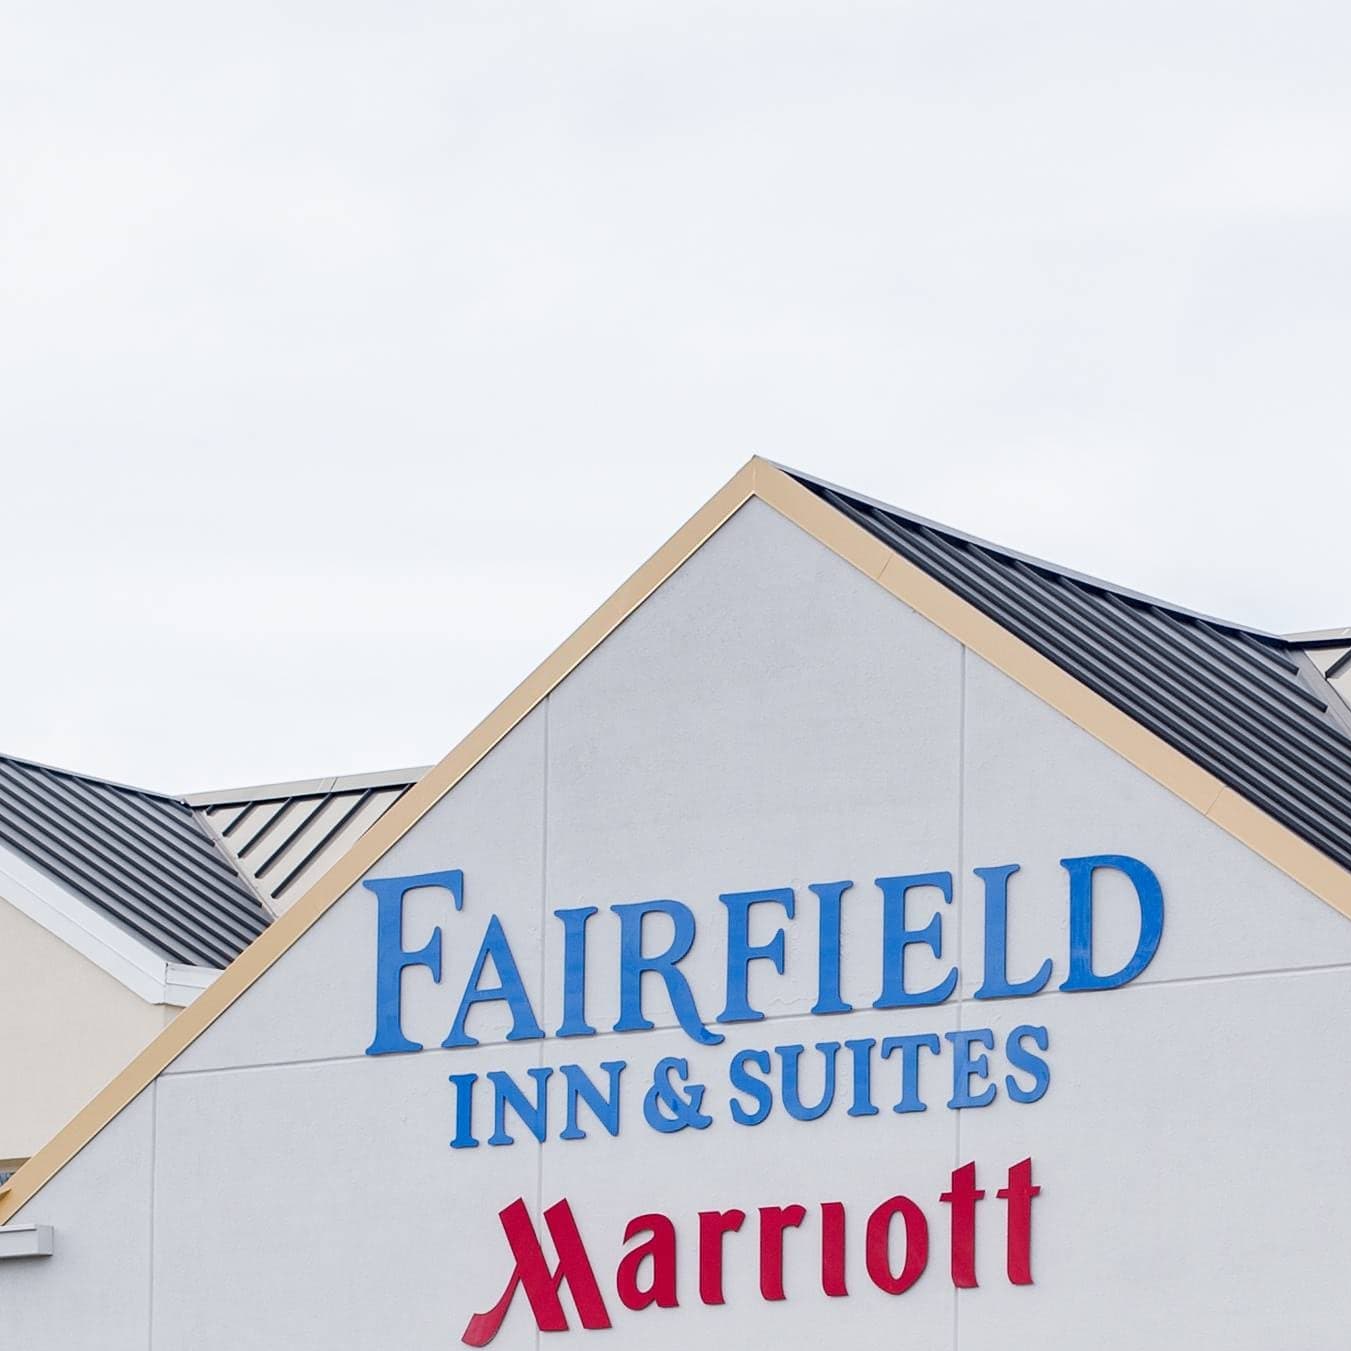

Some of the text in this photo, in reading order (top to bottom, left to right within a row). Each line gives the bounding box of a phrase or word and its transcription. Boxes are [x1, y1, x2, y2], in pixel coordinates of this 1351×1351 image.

[362, 853, 1165, 1057] FAIRFIELD
[448, 1024, 1051, 1149] INN & SUITES
[463, 1159, 1040, 1346] Marriott
